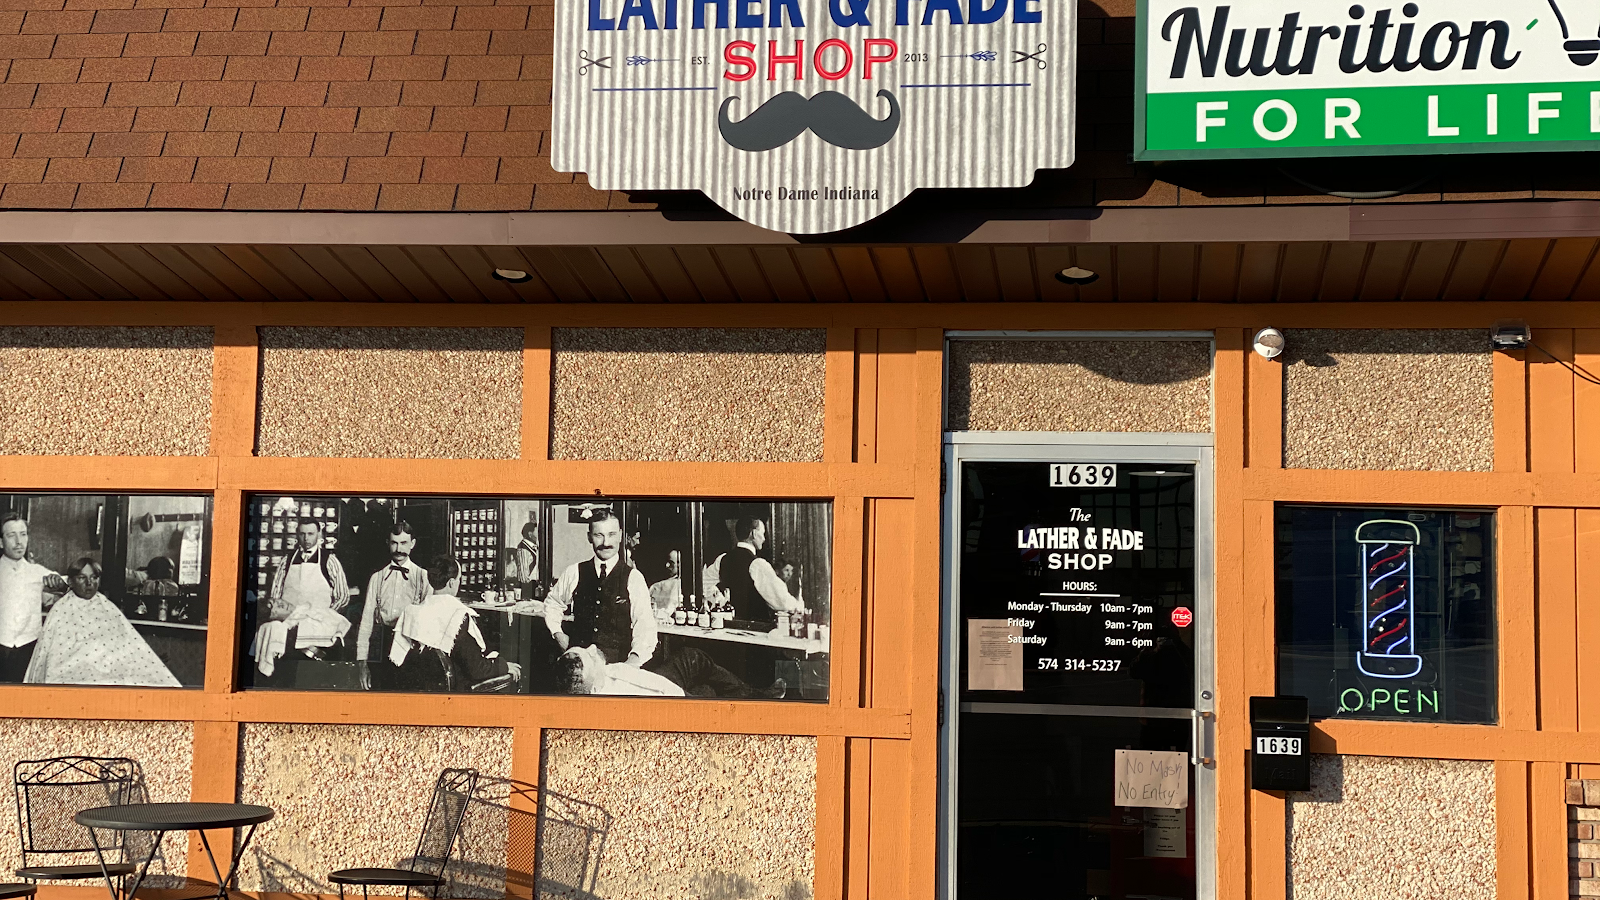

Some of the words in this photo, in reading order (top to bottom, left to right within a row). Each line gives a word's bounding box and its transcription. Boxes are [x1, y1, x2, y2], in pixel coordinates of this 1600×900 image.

[1161, 3, 1521, 79] Nutrition
[691, 56, 710, 65] EST.
[723, 38, 898, 82] SHOP
[904, 53, 928, 62] 2013
[1196, 97, 1361, 142] FOR
[733, 187, 772, 200] Notre
[778, 187, 819, 200] Dame
[824, 186, 879, 200] Indiana
[1054, 465, 1114, 486] 1639
[1069, 507, 1092, 522] The
[1018, 527, 1080, 550] LATHER
[1084, 527, 1098, 550] &
[1102, 528, 1144, 551] FADE
[1048, 553, 1113, 571] SHOP
[1062, 581, 1098, 592] HOURS:
[1007, 601, 1044, 614] Monday
[1050, 601, 1092, 614] Thursday
[1099, 603, 1125, 614] 10am
[1132, 603, 1153, 615] 7pm
[1007, 617, 1035, 630] Friday
[1104, 620, 1125, 630] 9am
[1132, 620, 1153, 632] 7pm
[1007, 634, 1047, 646] Saturday
[1104, 636, 1125, 647] 9am
[1132, 637, 1153, 648] 6pm
[1037, 658, 1059, 670] 574
[1064, 658, 1122, 672] 314-5237
[1340, 688, 1438, 713] OPEN
[1260, 738, 1300, 753] 1639
[1126, 758, 1144, 776] No
[1118, 781, 1137, 800] No
